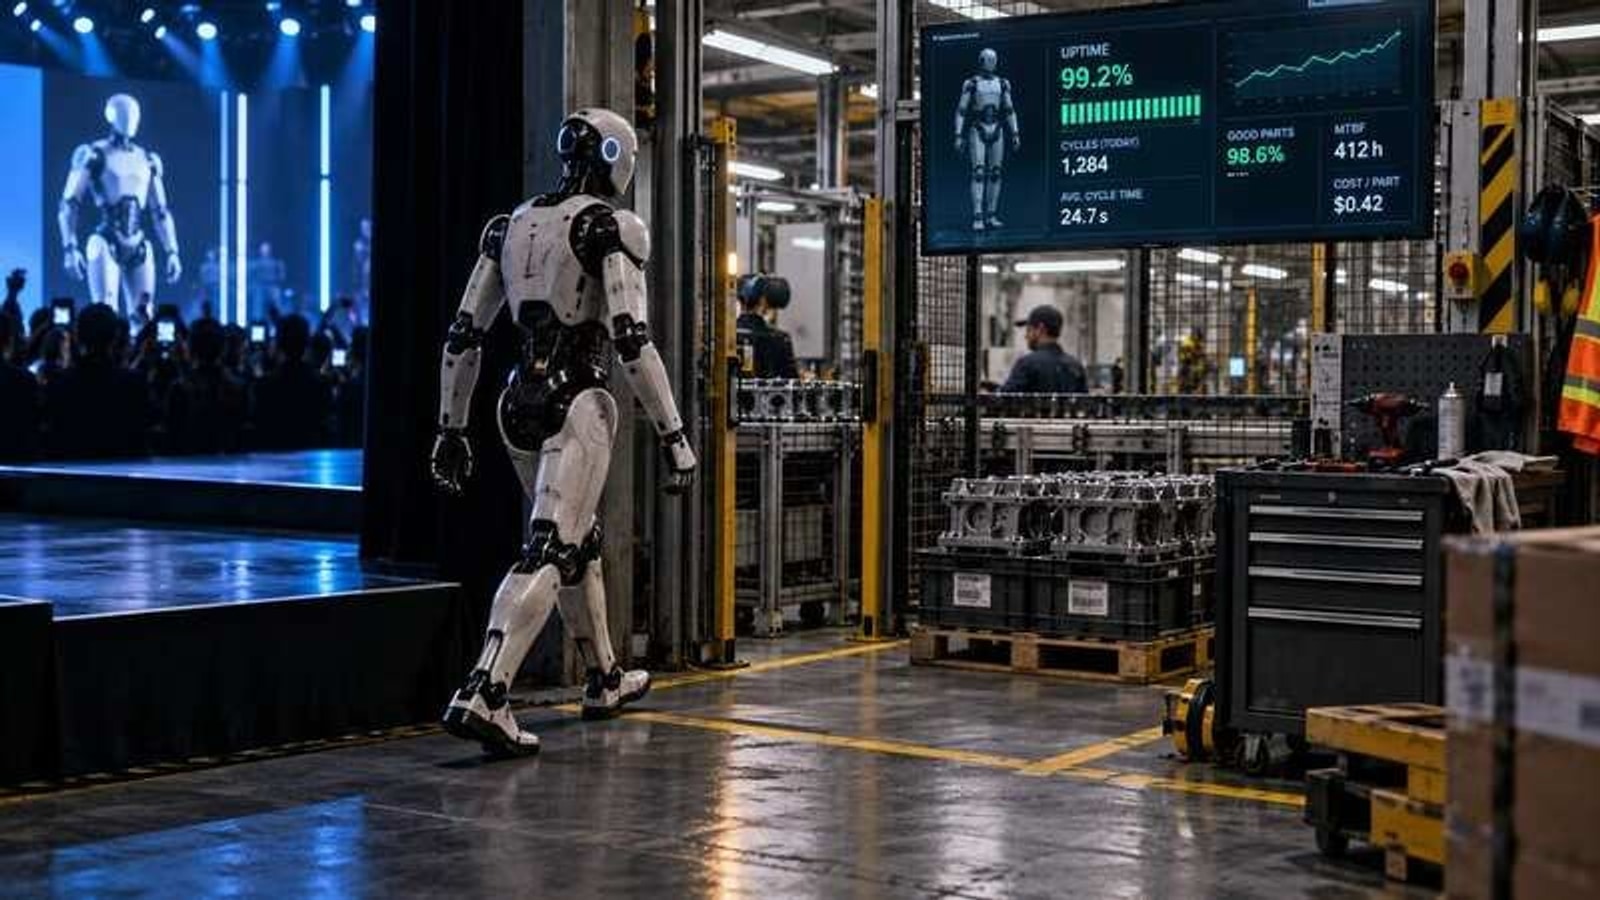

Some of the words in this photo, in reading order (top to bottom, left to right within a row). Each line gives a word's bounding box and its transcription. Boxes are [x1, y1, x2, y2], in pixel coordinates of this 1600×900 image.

[1061, 42, 1111, 59] UPTIME
[1061, 64, 1134, 90] 99.2%
[1227, 130, 1259, 142] GOOD
[1260, 126, 1295, 139] PARTS
[1227, 144, 1285, 166] 98.6%
[1062, 154, 1108, 176] 1,284
[1334, 177, 1362, 189] COST
[1372, 175, 1400, 188] PART
[1119, 188, 1144, 200] TIME
[1334, 194, 1384, 215] $0.42
